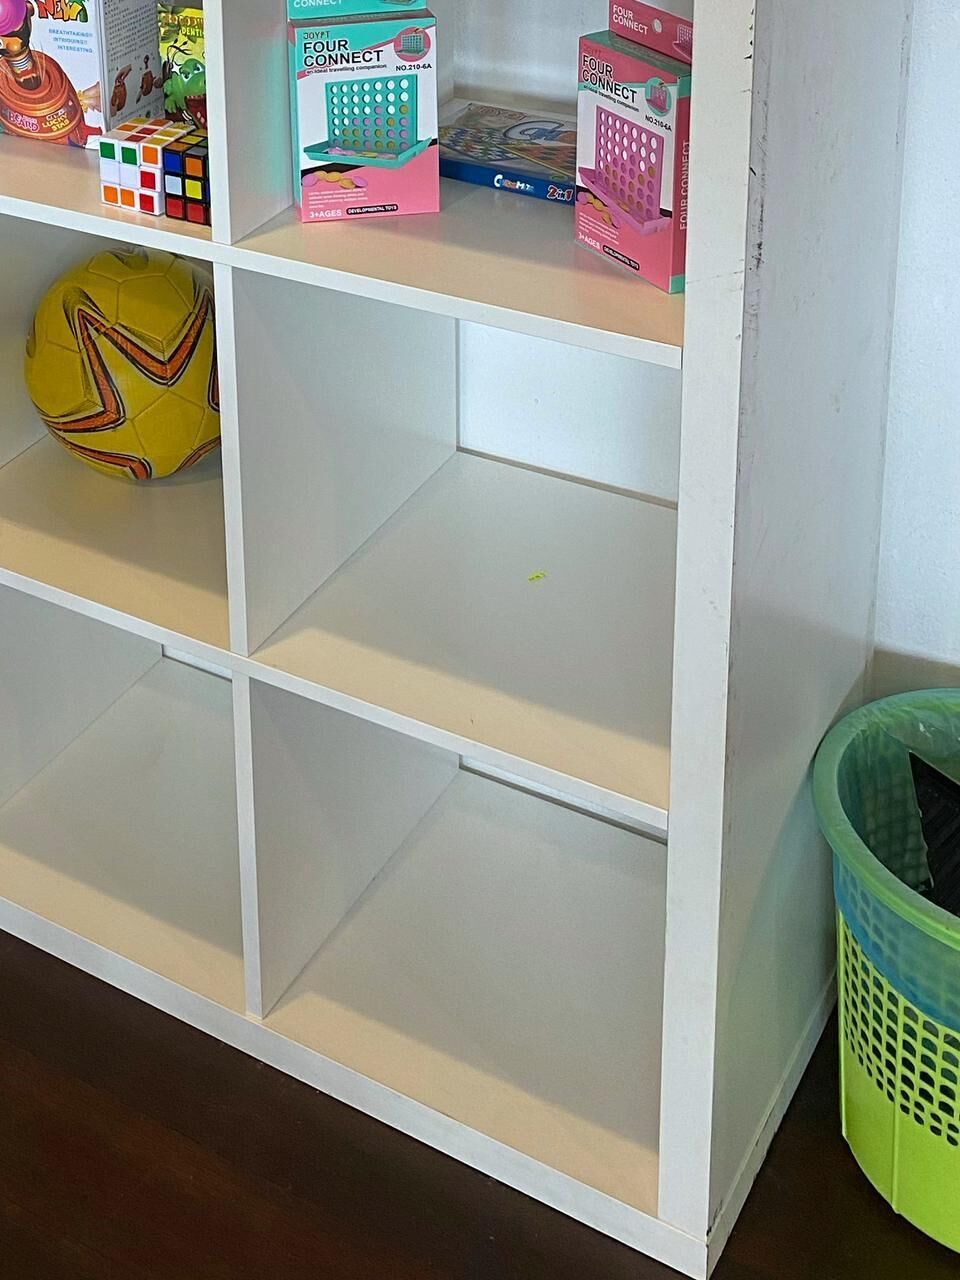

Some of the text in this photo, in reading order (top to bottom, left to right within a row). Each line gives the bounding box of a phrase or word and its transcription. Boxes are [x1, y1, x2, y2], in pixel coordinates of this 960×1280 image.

[612, 4, 634, 21] FOUR
[612, 13, 648, 35] CONNECT
[57, 45, 93, 54] INTERESTING
[303, 39, 349, 55] FOUR
[303, 50, 383, 67] CONNECT
[582, 54, 613, 79] FOUR
[329, 65, 355, 73] travelling
[395, 63, 432, 72] NO.210-6A
[582, 68, 637, 103] CONNECT
[42, 112, 68, 128] LUCKY
[546, 184, 574, 201] 2in1
[309, 209, 343, 219] 3+AGES
[347, 206, 385, 214] DEVELOPMENTAL
